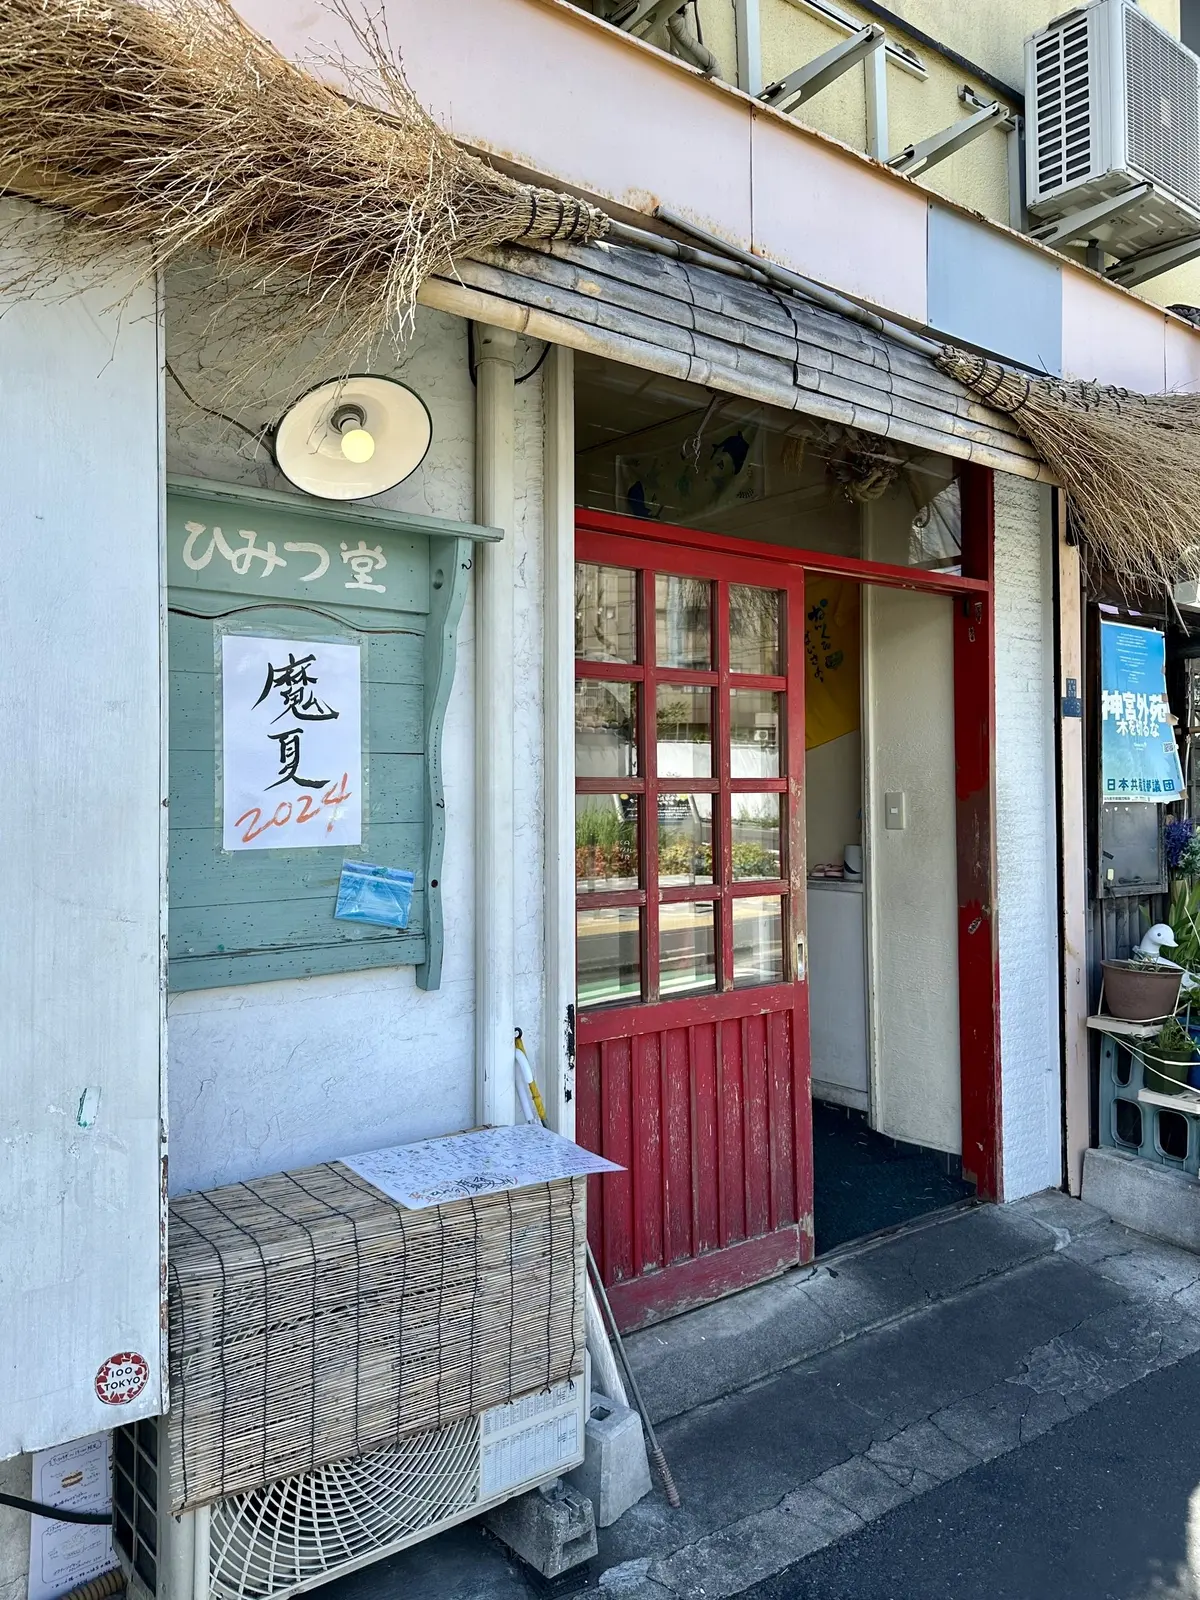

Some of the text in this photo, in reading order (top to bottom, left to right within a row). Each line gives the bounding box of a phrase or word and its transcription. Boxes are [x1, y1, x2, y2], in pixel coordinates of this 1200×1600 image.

[182, 521, 388, 593] ひみつ堂
[251, 653, 340, 792] 魔夏
[234, 773, 352, 842] 2024
[104, 1376, 141, 1391] TOKYO
[111, 1366, 133, 1378] 100
